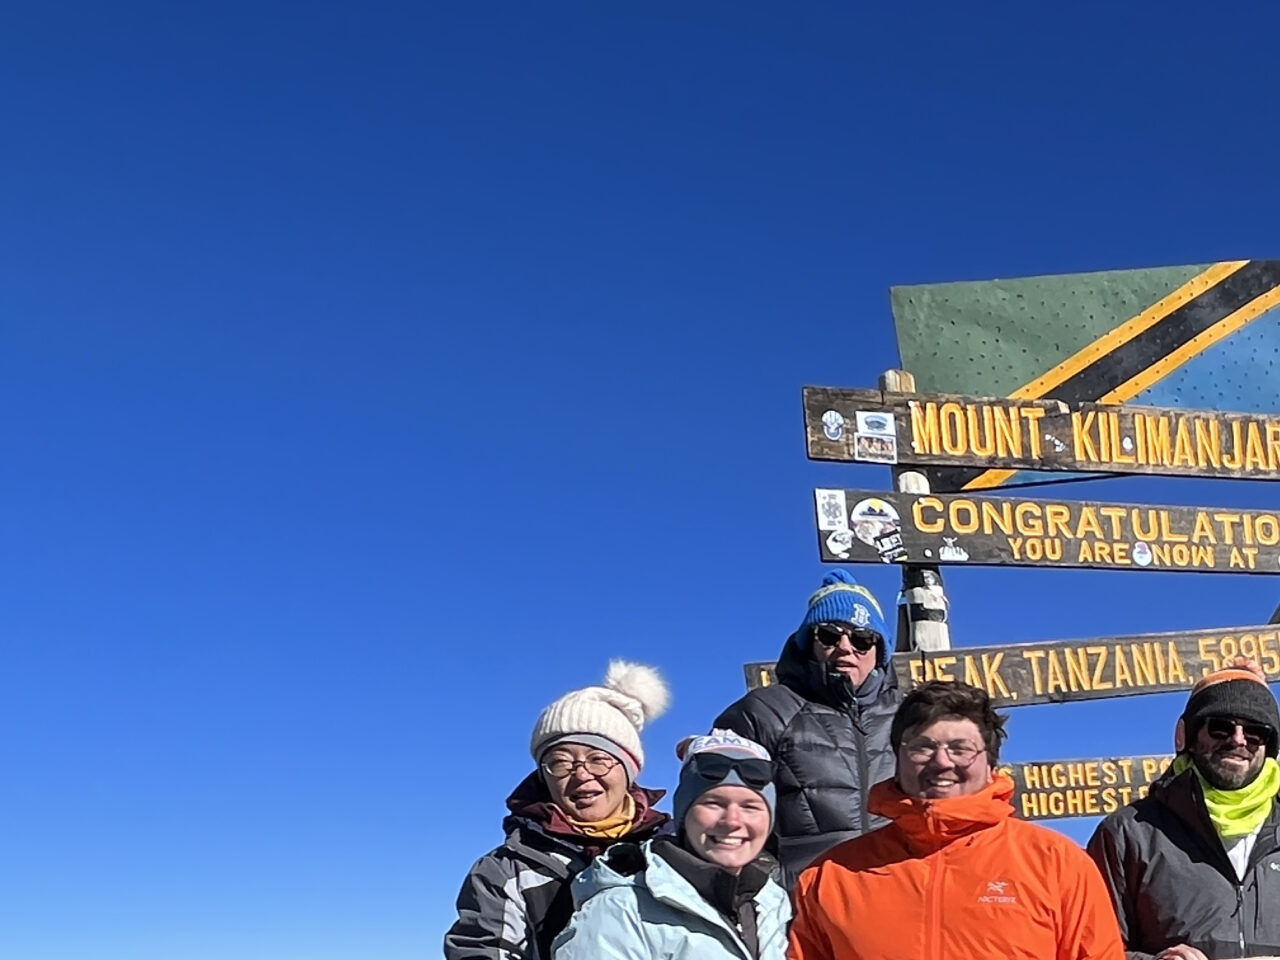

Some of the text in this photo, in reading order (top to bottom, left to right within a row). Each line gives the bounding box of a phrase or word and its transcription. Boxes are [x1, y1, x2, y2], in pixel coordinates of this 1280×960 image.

[911, 400, 1046, 460] MOUNT
[1008, 537, 1259, 570] YOU ARE NOW AT
[1022, 640, 1195, 696] TANZANIA,
[1023, 758, 1132, 790] HIGHEST
[1021, 786, 1132, 818] HIGHEST
